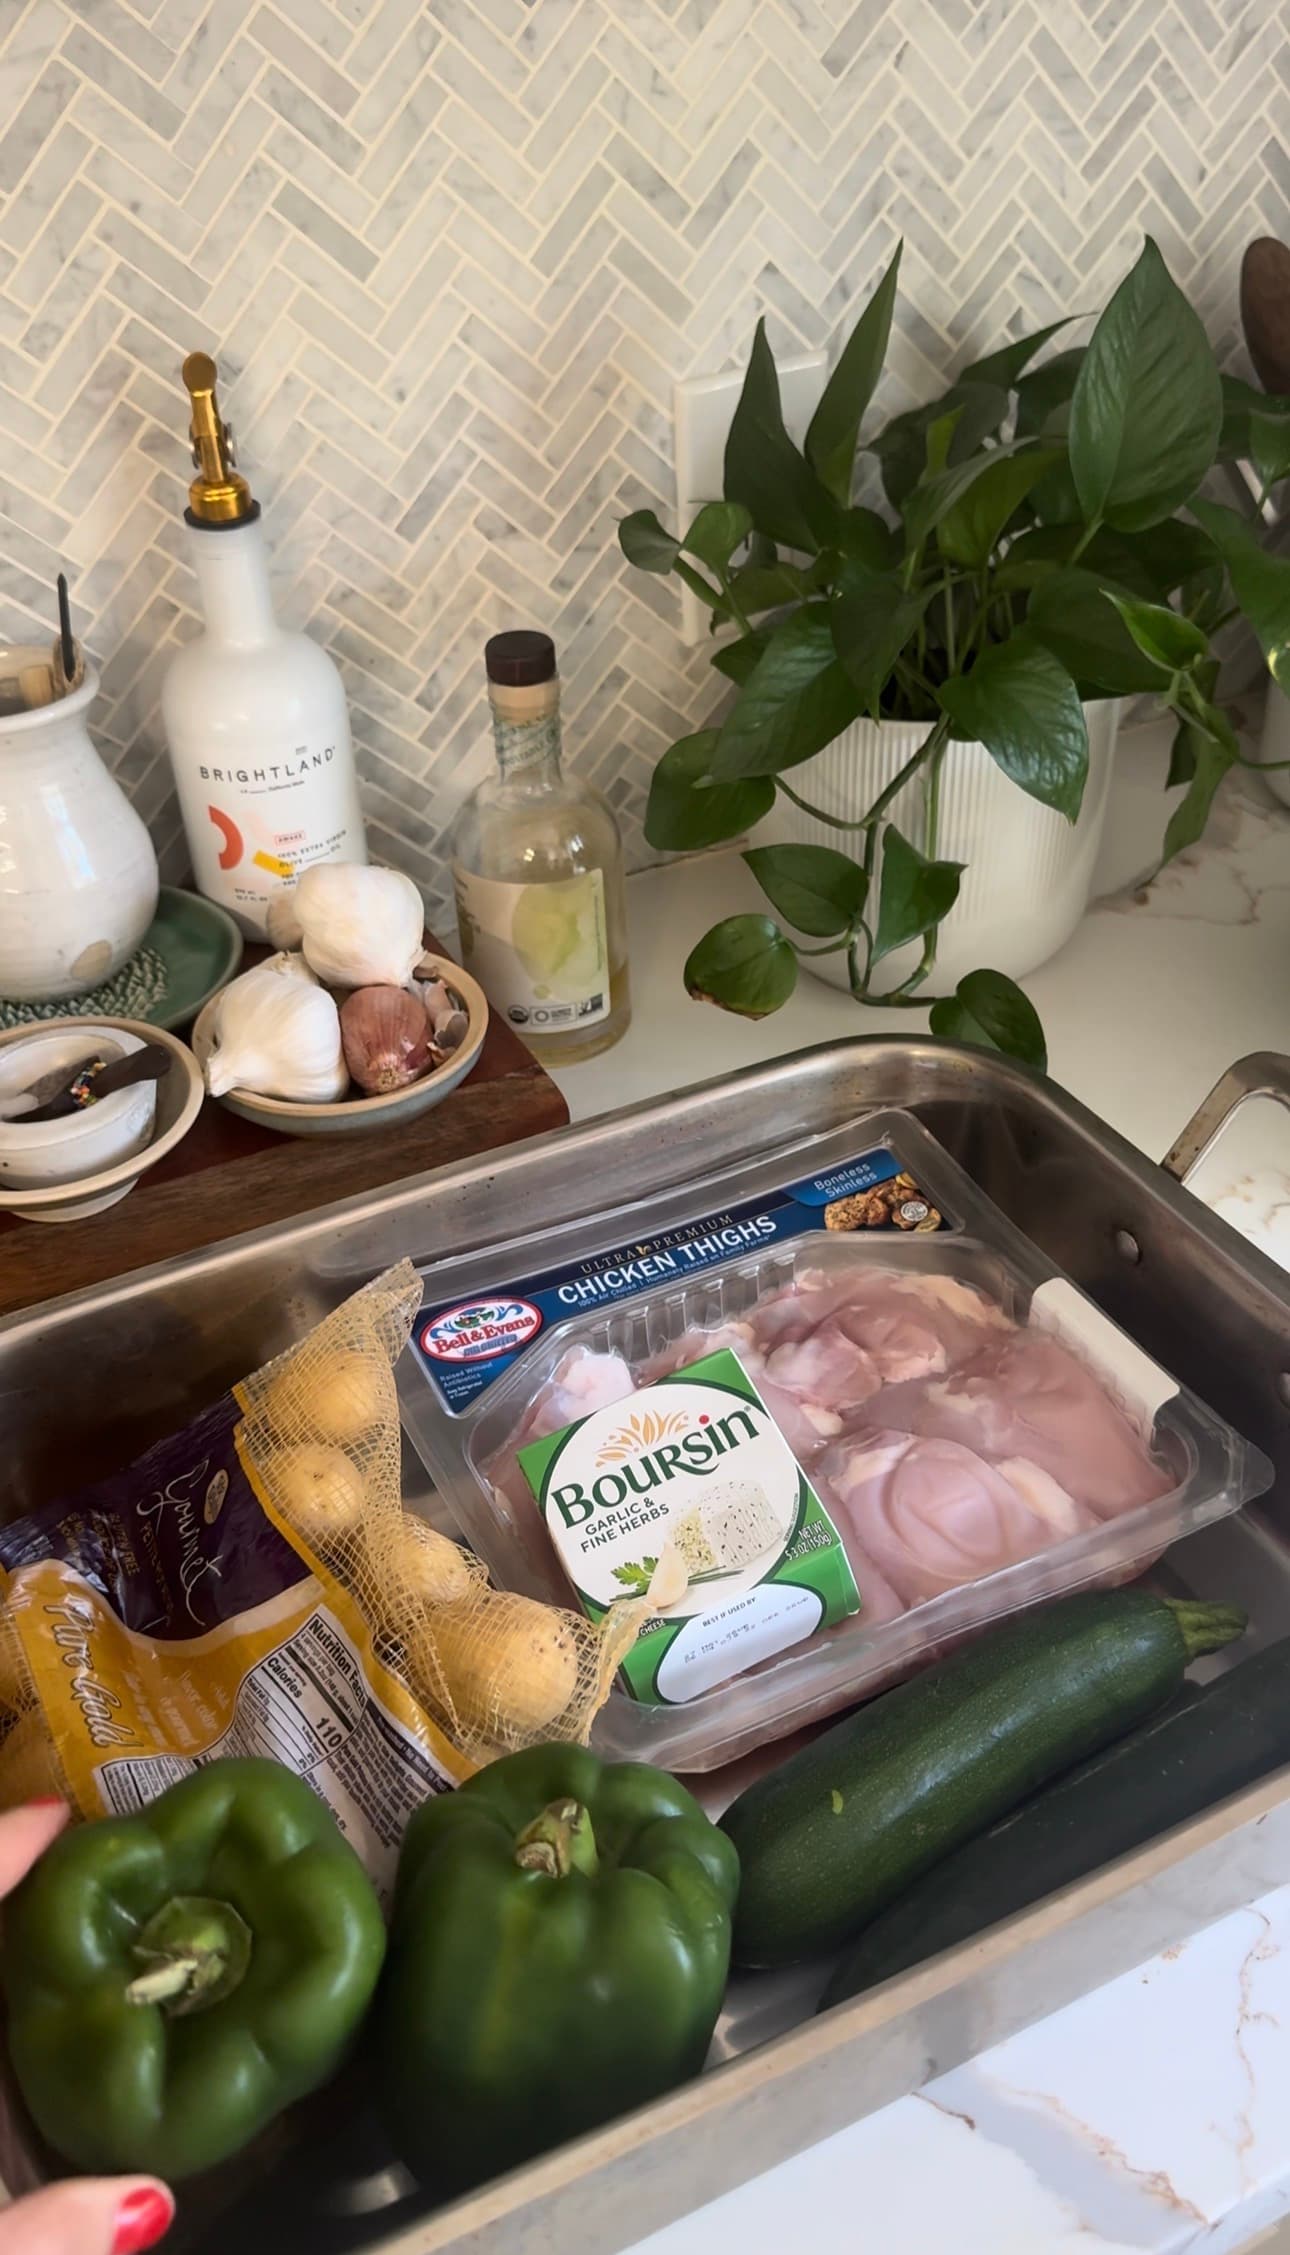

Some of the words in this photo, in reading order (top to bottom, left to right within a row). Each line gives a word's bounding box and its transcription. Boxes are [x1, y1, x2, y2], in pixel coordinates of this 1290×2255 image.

[199, 746, 335, 783] BRIGHTLAND
[813, 1163, 871, 1191] Boneless
[825, 1172, 877, 1198] Skinless
[558, 1251, 676, 1304] CHICKEN
[678, 1214, 777, 1262] THIGHS
[580, 1250, 635, 1275] ULTRA
[653, 1214, 734, 1250] PREMIUM
[581, 1531, 617, 1554] FINE
[620, 1504, 670, 1537] HERBS
[584, 1505, 641, 1535] GARLIC
[643, 1497, 655, 1508] &
[799, 1525, 813, 1541] NET
[812, 1520, 826, 1534] WT
[640, 1618, 666, 1636] CHEESE
[702, 1615, 719, 1628] BEST
[720, 1611, 727, 1619] IF
[727, 1602, 746, 1616] USED
[746, 1597, 757, 1607] BY
[308, 1618, 352, 1675] Nutrition
[42, 1592, 98, 1672] Pure
[72, 1667, 146, 1752] Gold
[267, 1656, 303, 1699] Calories
[316, 1717, 342, 1749] 110
